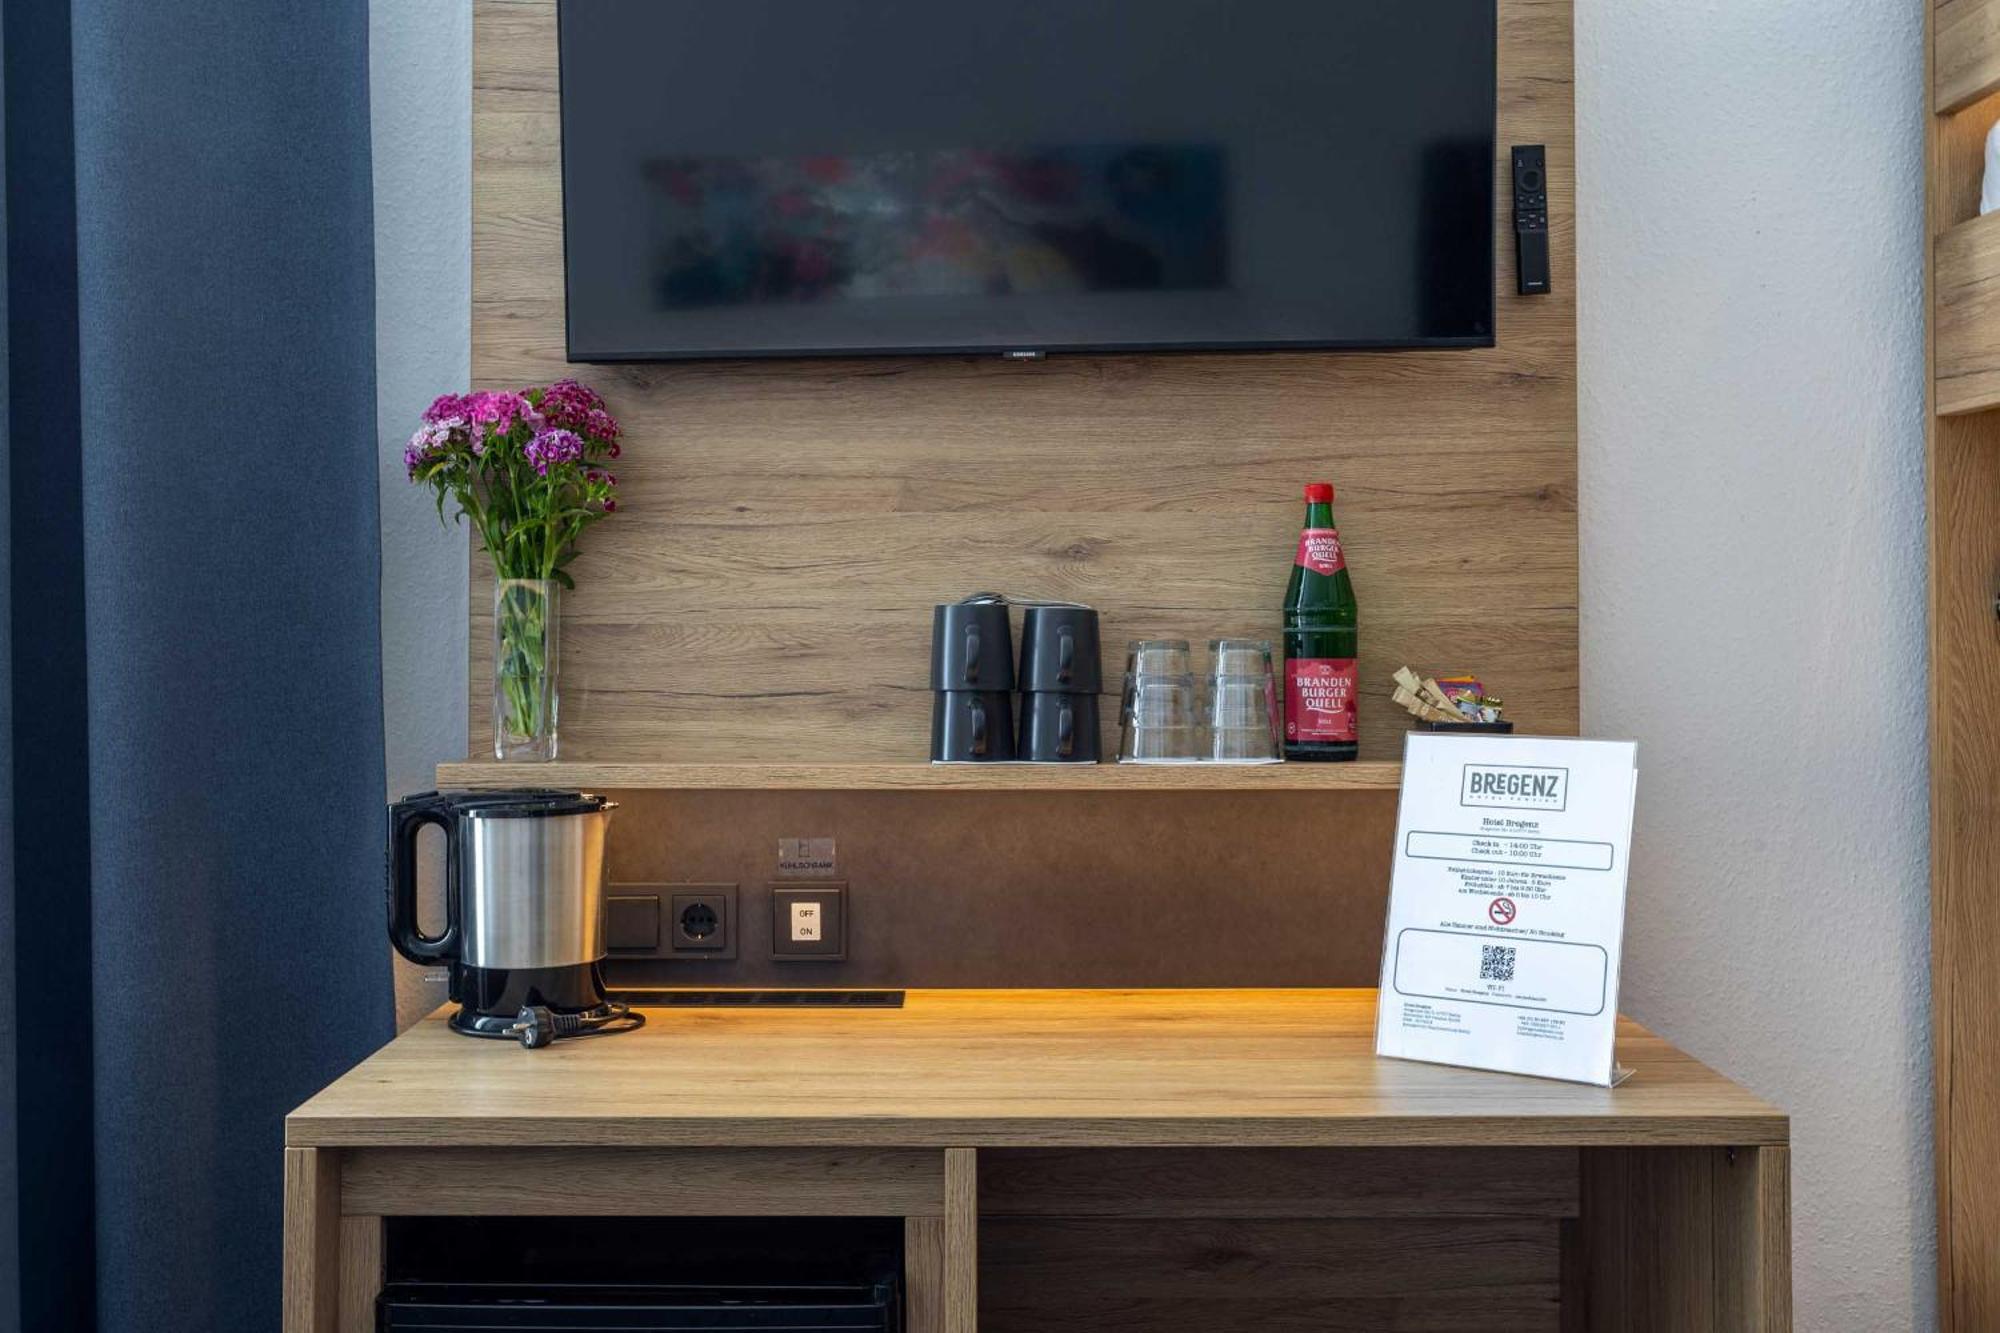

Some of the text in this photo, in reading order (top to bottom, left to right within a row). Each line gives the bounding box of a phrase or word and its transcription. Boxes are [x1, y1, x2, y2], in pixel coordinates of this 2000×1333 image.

[1296, 677, 1351, 687] BRANDEN
[1302, 687, 1347, 697] BURGER
[1306, 698, 1344, 711] QUELL
[1470, 772, 1559, 797] BREGENZ
[1482, 817, 1540, 829] Hotel Bregenz
